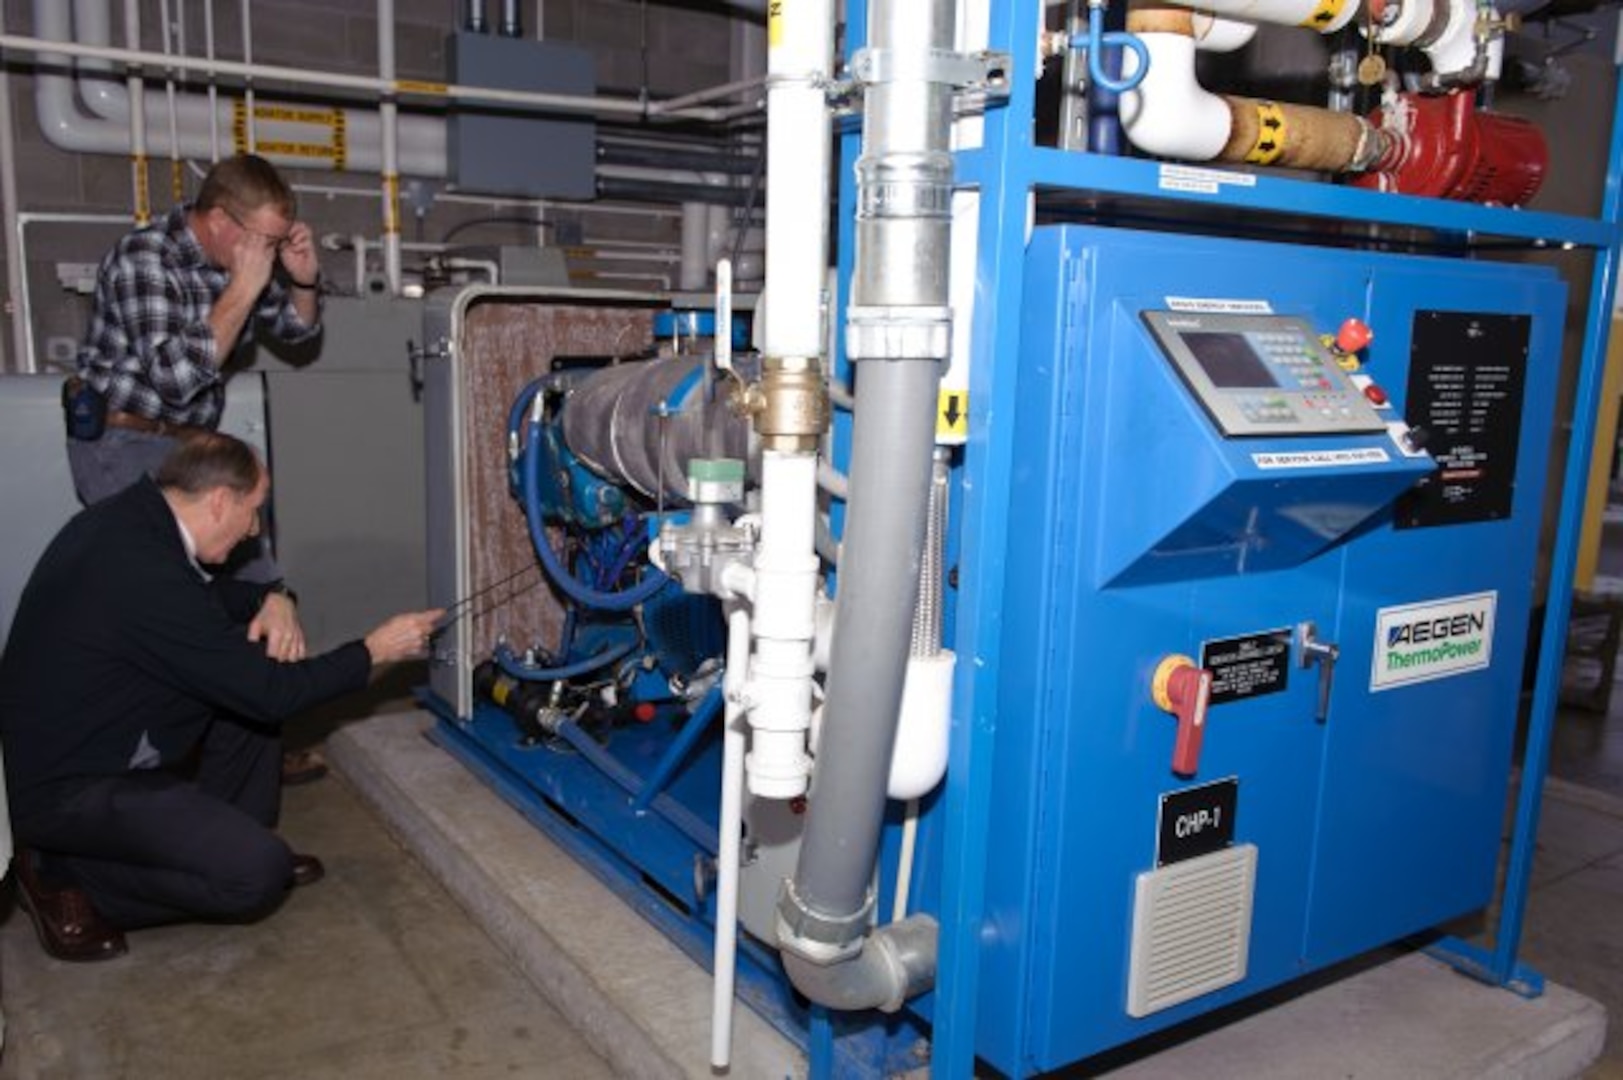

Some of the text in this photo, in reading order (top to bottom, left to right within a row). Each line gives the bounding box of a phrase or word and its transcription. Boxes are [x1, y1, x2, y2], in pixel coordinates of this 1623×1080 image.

[1388, 610, 1485, 648] AEGEN
[1387, 639, 1482, 670] ThermoPower
[1175, 805, 1221, 838] CHP-1
